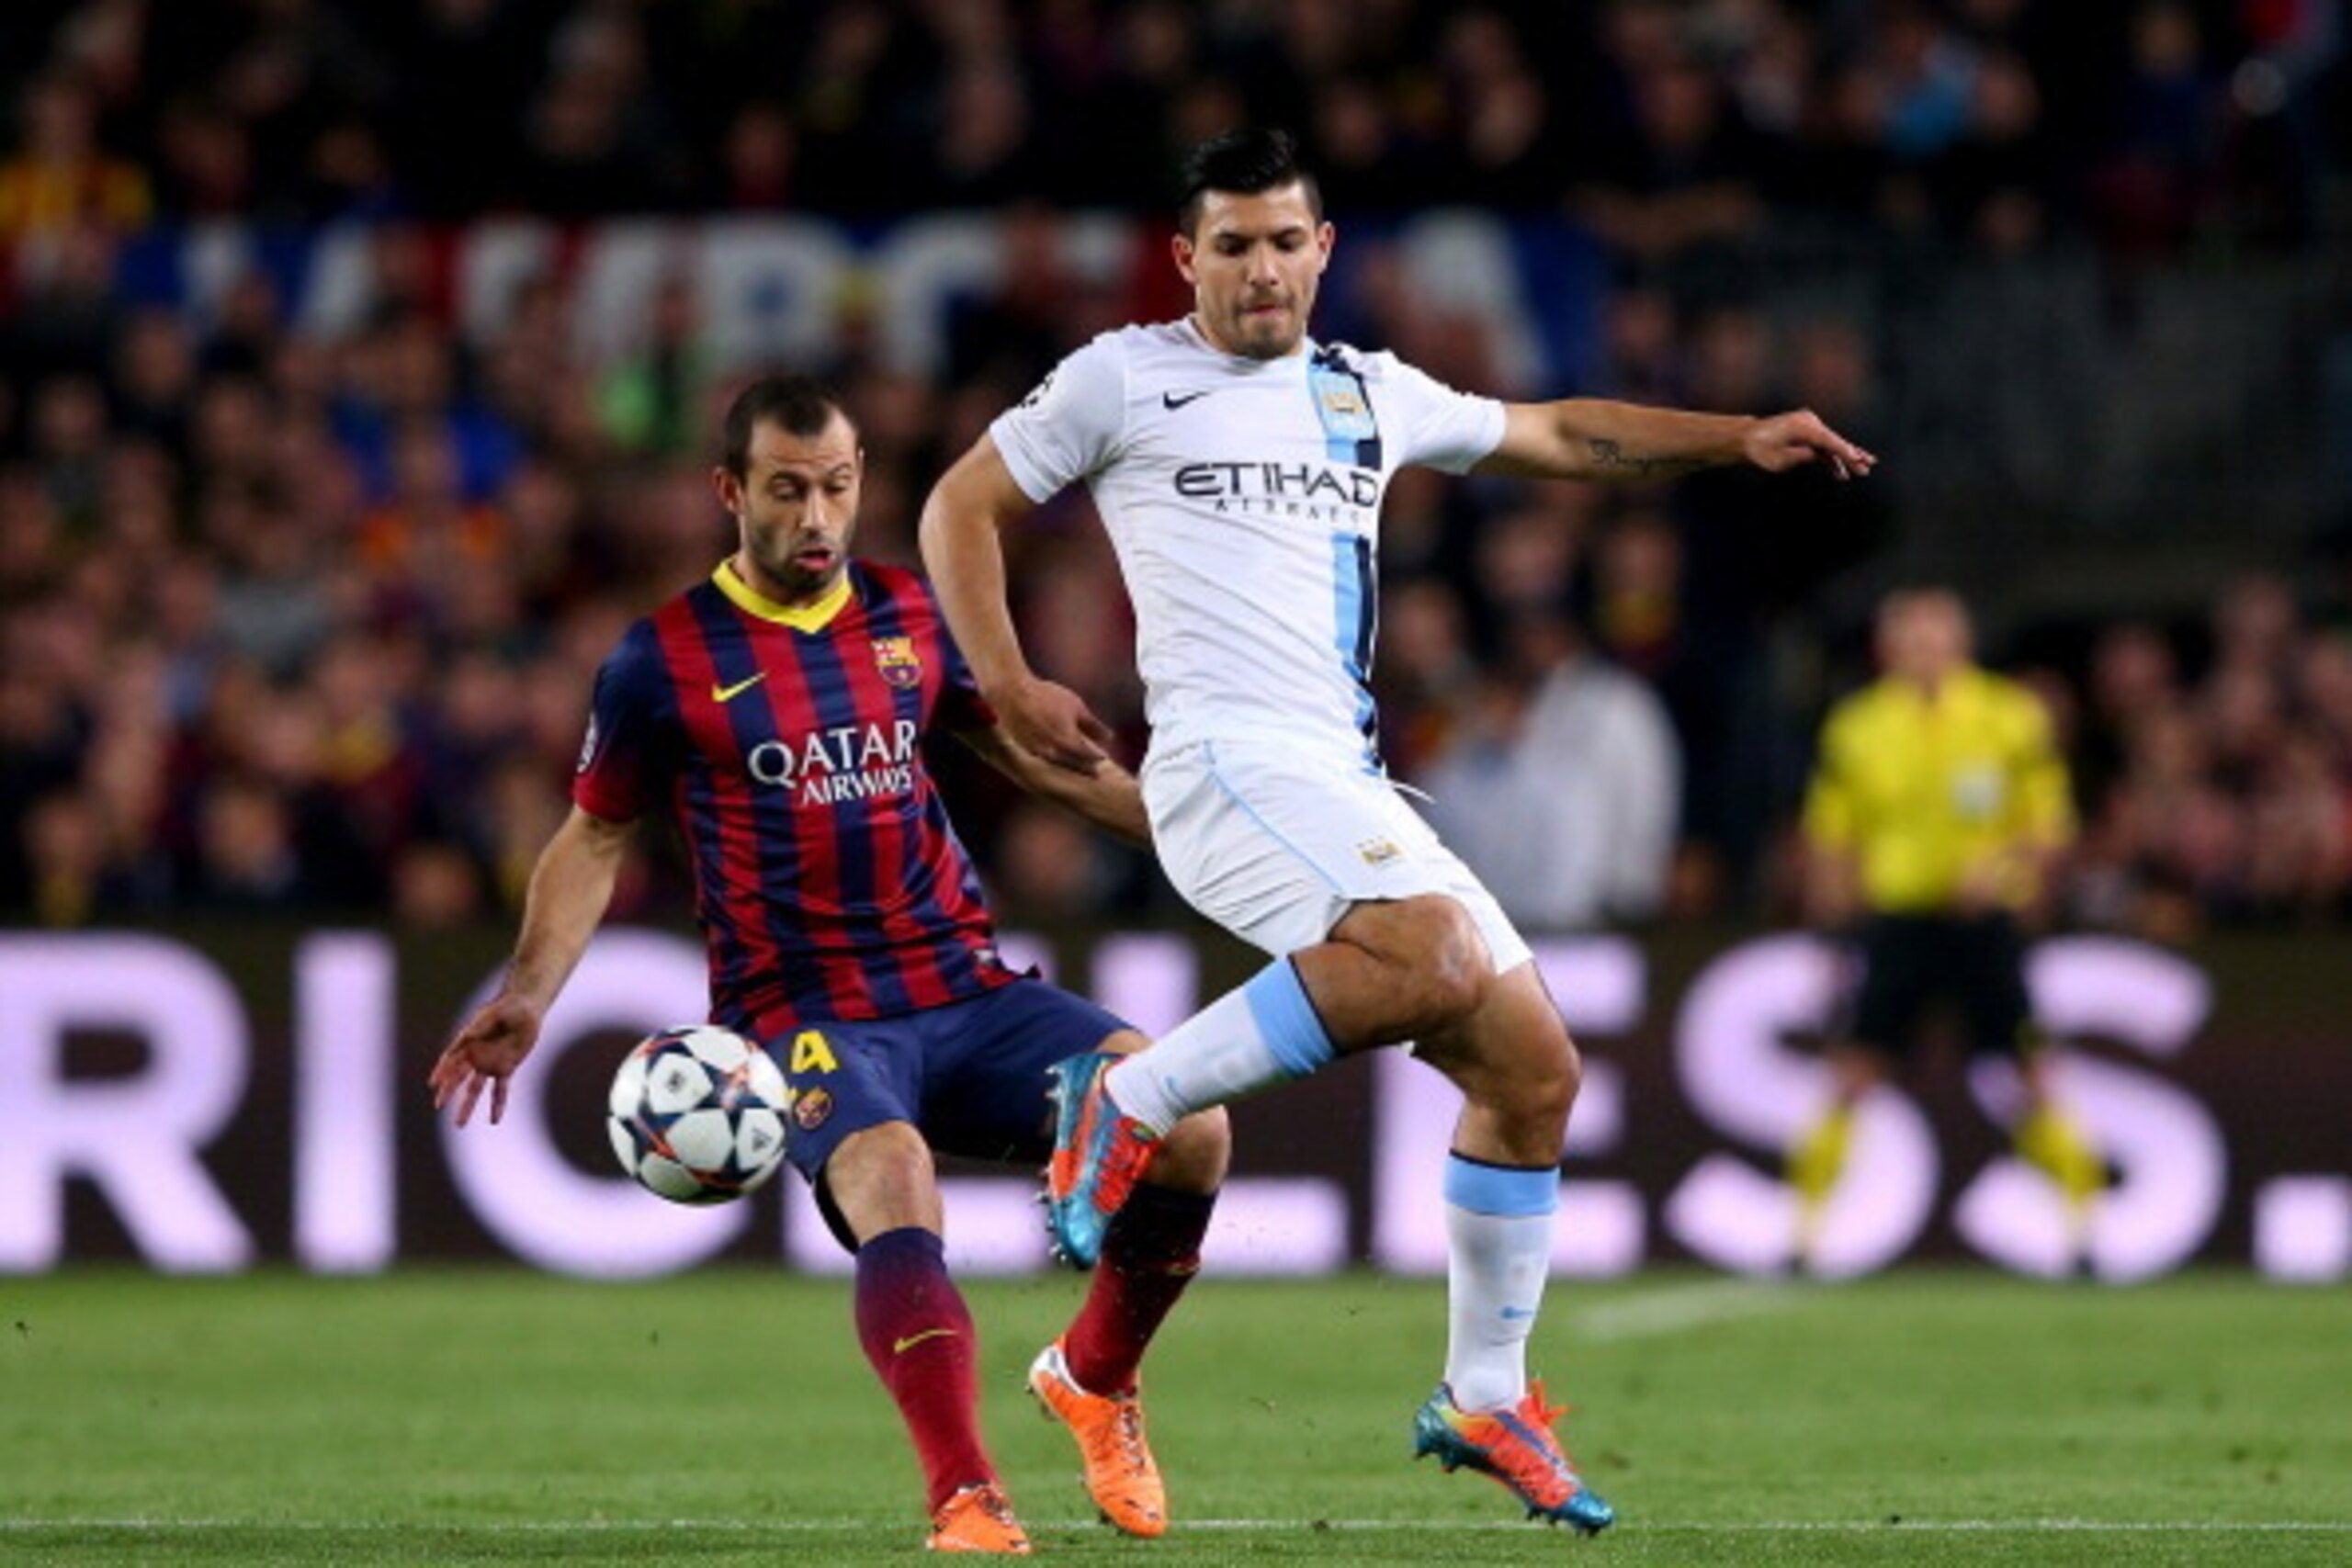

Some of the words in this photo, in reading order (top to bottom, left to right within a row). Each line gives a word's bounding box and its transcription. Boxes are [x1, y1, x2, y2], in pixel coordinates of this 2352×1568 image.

[1175, 462, 1378, 507] ETIHAD
[747, 719, 916, 789] QATAR
[801, 764, 912, 807] AIRWAYS
